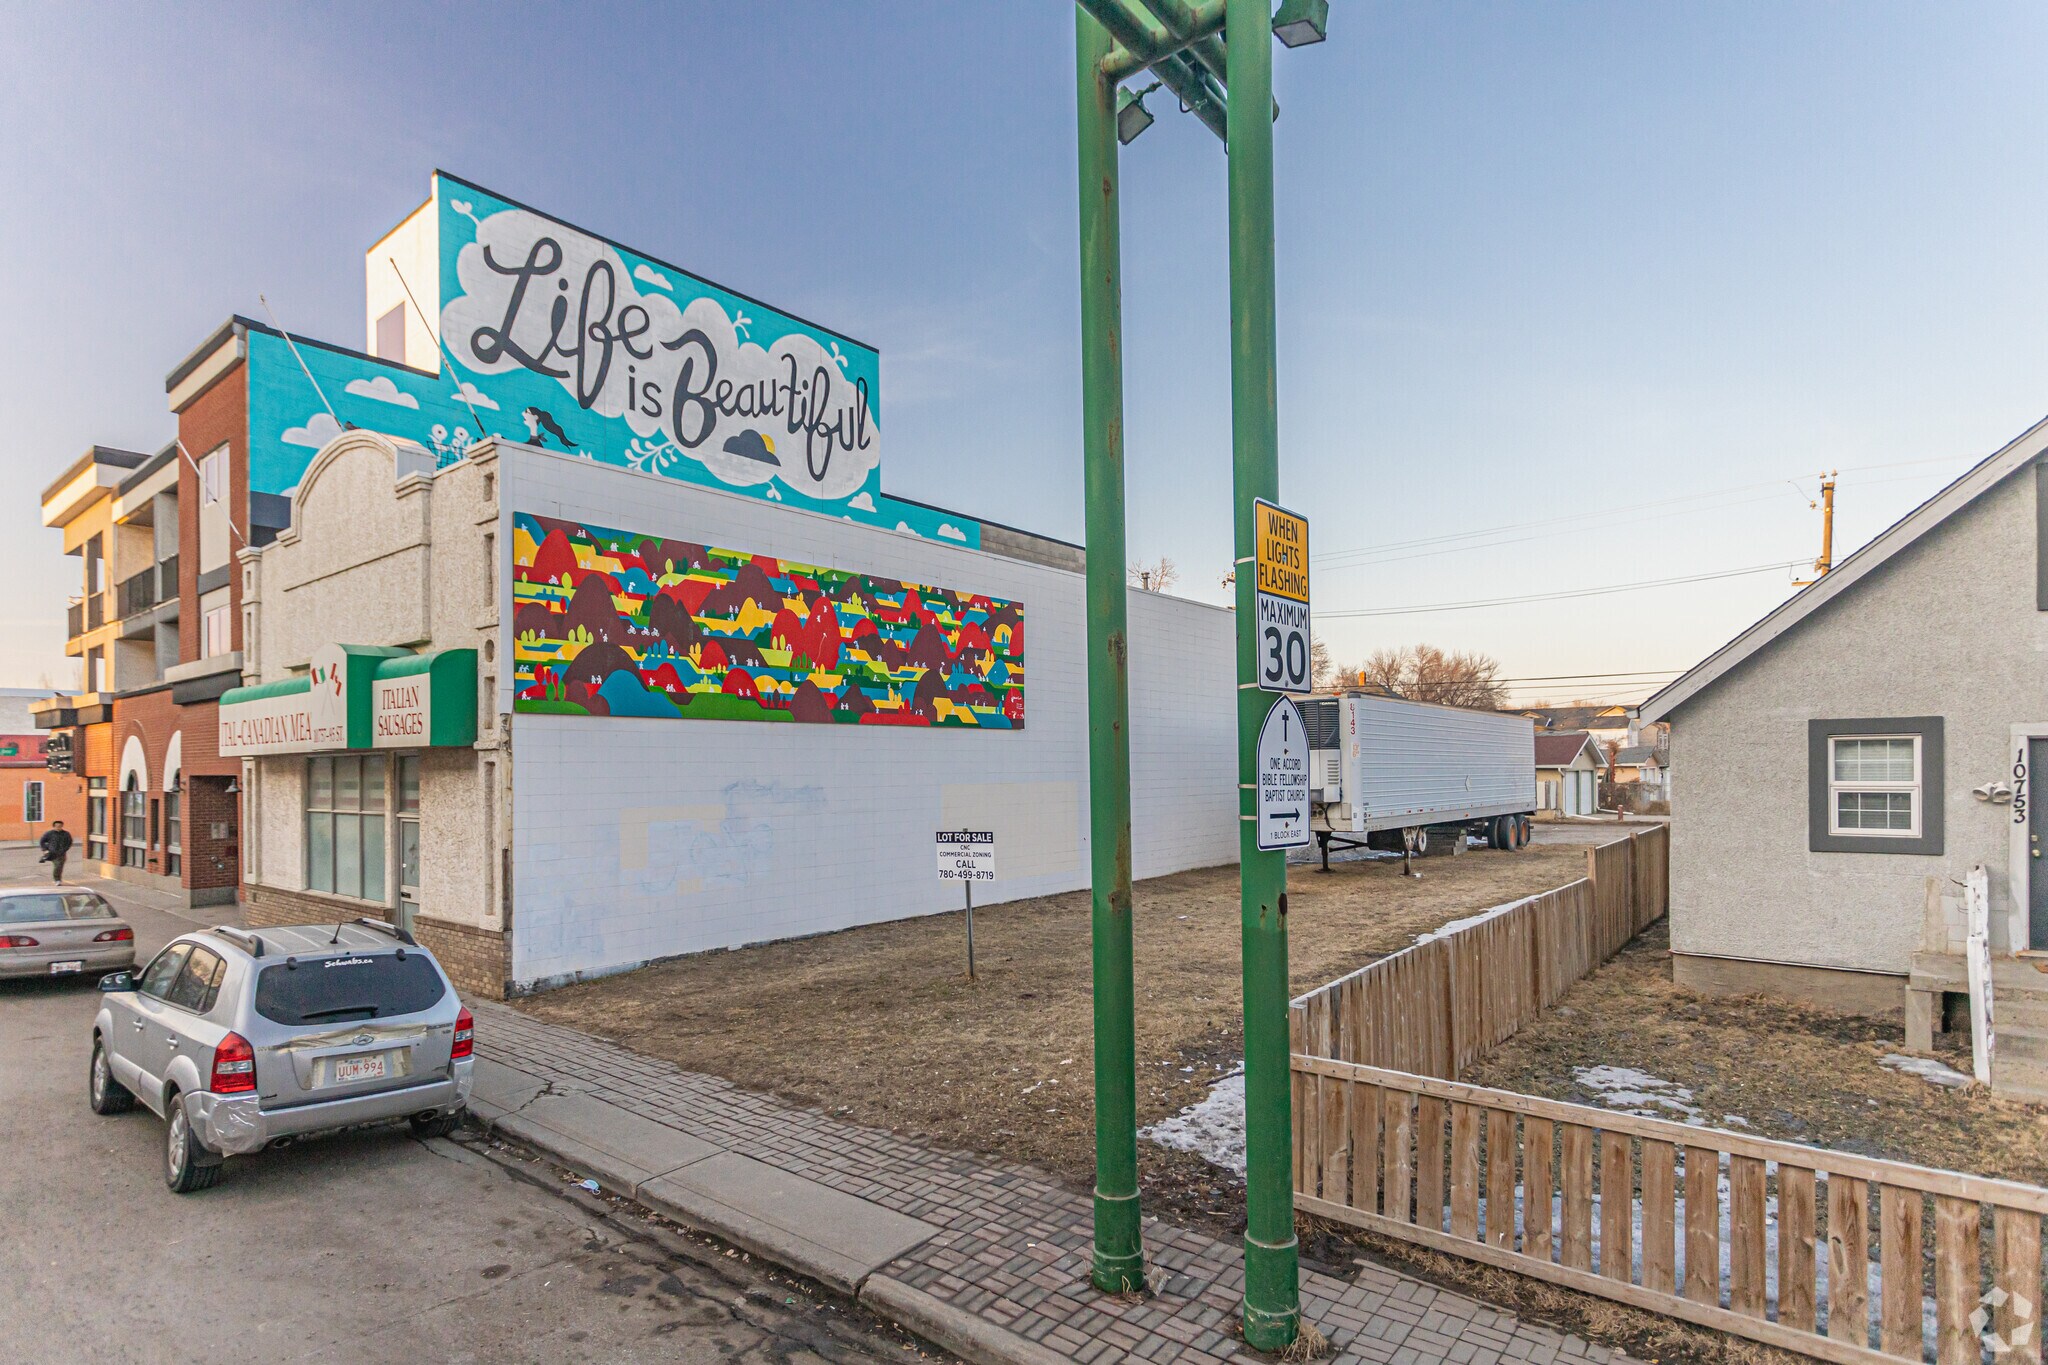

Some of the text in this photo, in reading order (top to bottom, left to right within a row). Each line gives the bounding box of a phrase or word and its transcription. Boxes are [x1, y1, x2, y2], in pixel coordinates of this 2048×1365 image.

[470, 237, 653, 410] Life
[628, 365, 662, 417] is
[659, 329, 871, 482] Beautiful
[1268, 511, 1298, 544] WHEN
[1266, 538, 1300, 570] LIGHTS
[1259, 563, 1307, 597] FLASHING
[1261, 598, 1307, 630] MAXIMUM
[1264, 626, 1306, 685] 30
[382, 685, 419, 710] ITALIAN
[290, 712, 313, 742] MEA
[378, 712, 423, 737] SAUSAGES
[1270, 757, 1301, 770] ONE ACCORD
[1262, 773, 1307, 786] BIBLE FELLOWSHIP
[2013, 748, 2027, 824] 10753
[1265, 789, 1305, 802] BAPTIST CHURCH
[937, 833, 992, 842] LOT FOR SALE
[1274, 831, 1290, 840] BLOCK
[1291, 829, 1302, 838] EAST
[939, 870, 994, 879] 780-499-8719
[955, 860, 976, 868] CALL
